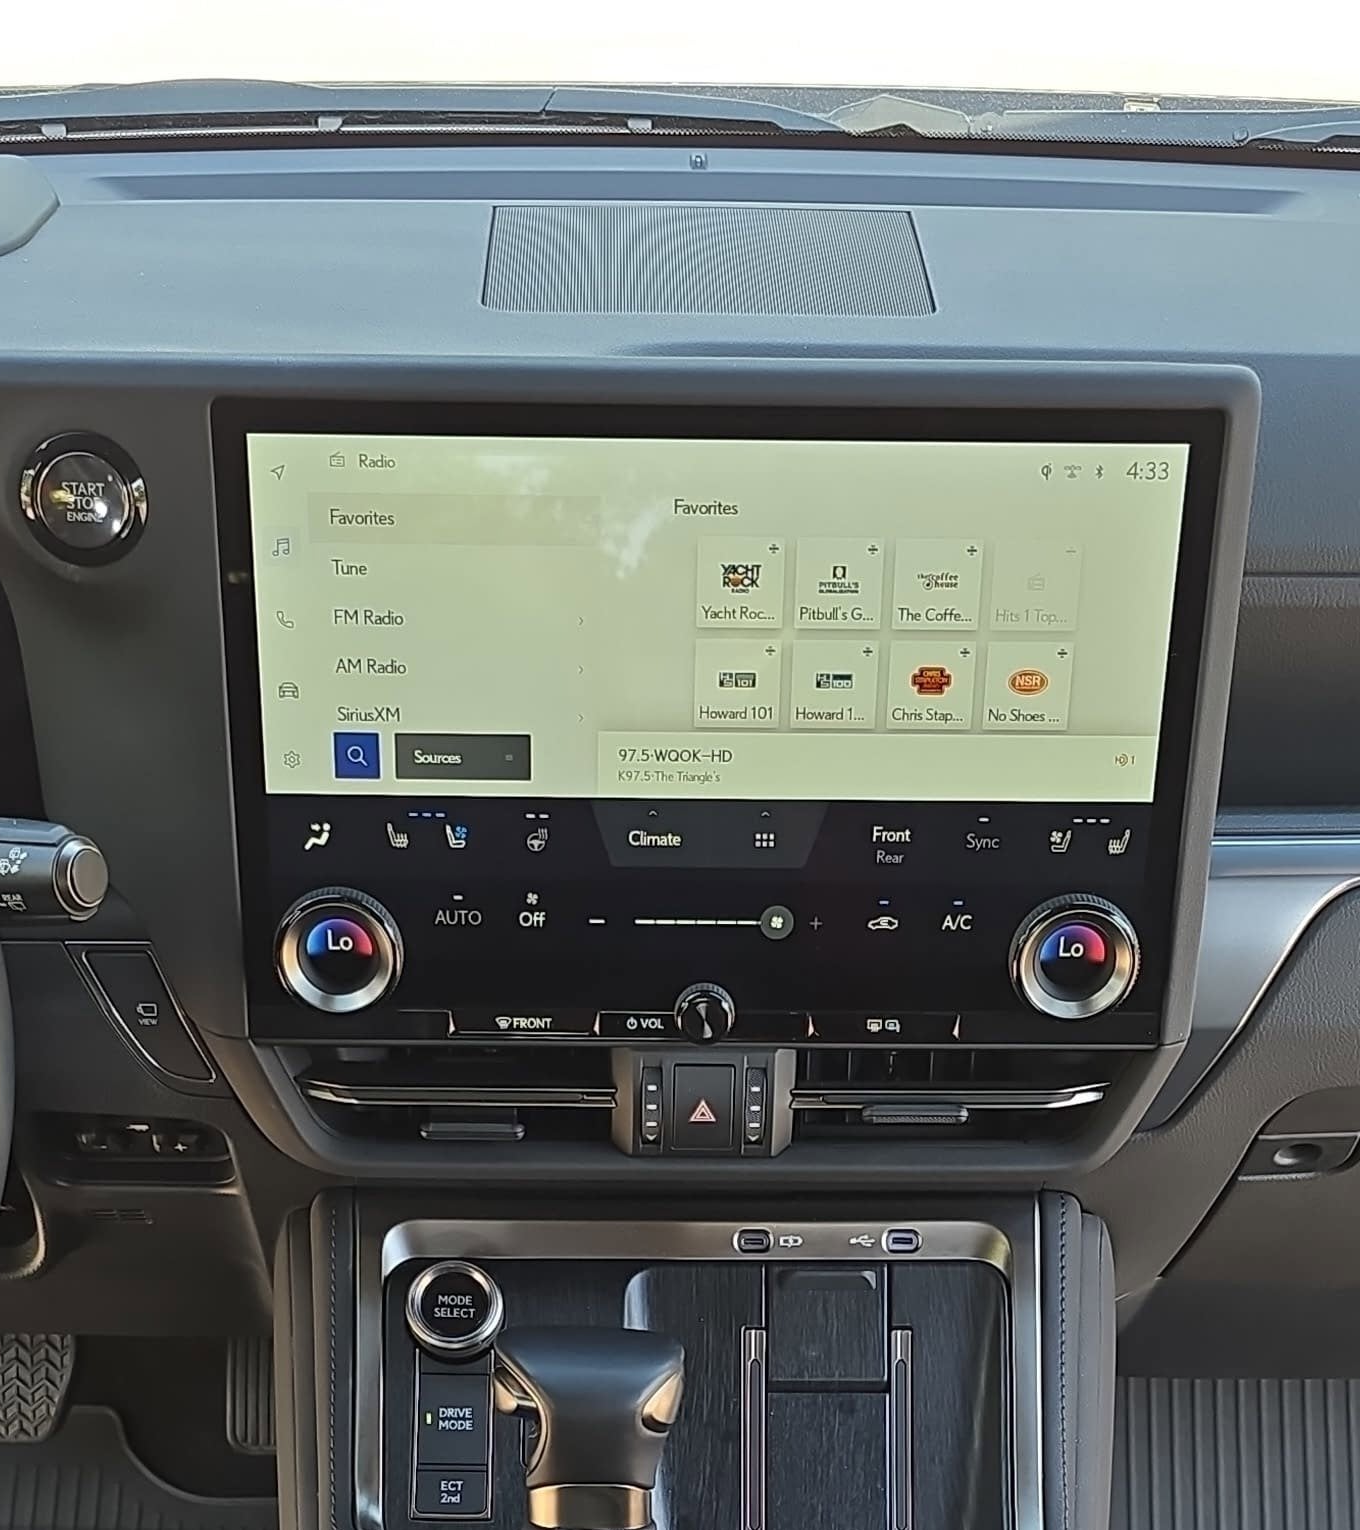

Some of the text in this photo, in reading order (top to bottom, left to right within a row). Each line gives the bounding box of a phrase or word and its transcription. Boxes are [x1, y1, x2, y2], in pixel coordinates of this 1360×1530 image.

[358, 453, 396, 469] Radio
[1126, 461, 1170, 480] 4:33
[61, 482, 105, 496] START
[674, 498, 739, 515] Favorites
[329, 508, 395, 526] Favorites
[331, 559, 368, 576] Tune
[720, 564, 762, 577] YACHT
[334, 609, 404, 626] FM Radio
[702, 605, 736, 621] Yacht
[800, 606, 848, 621] Pitbull's
[898, 607, 921, 622] The
[336, 658, 407, 675] AM Radio
[1015, 675, 1041, 687] NSR
[337, 706, 401, 722] SiriusXM
[699, 706, 773, 720] Howard 101
[796, 707, 844, 721] Howard
[892, 708, 923, 721] Chris
[989, 709, 1007, 722] No
[1010, 709, 1045, 722] Shoes
[413, 750, 462, 764] Sources
[677, 770, 720, 784] Triangle's
[628, 831, 682, 847] Climate
[872, 826, 911, 843] Front
[966, 833, 1000, 851] Sync
[876, 851, 904, 864] Rear
[435, 911, 482, 925] AUTO
[519, 911, 546, 927] Off
[941, 914, 973, 931] A/C
[327, 929, 354, 952] Lo
[1058, 935, 1084, 958] Lo
[513, 1018, 552, 1030] FRONT
[640, 1018, 664, 1030] VOL
[438, 1295, 473, 1306] MODE
[434, 1308, 476, 1319] SELECT
[439, 1408, 473, 1419] DRIVE
[438, 1420, 473, 1431] MODE
[440, 1481, 463, 1491] ECT
[440, 1493, 461, 1503] 2nd
